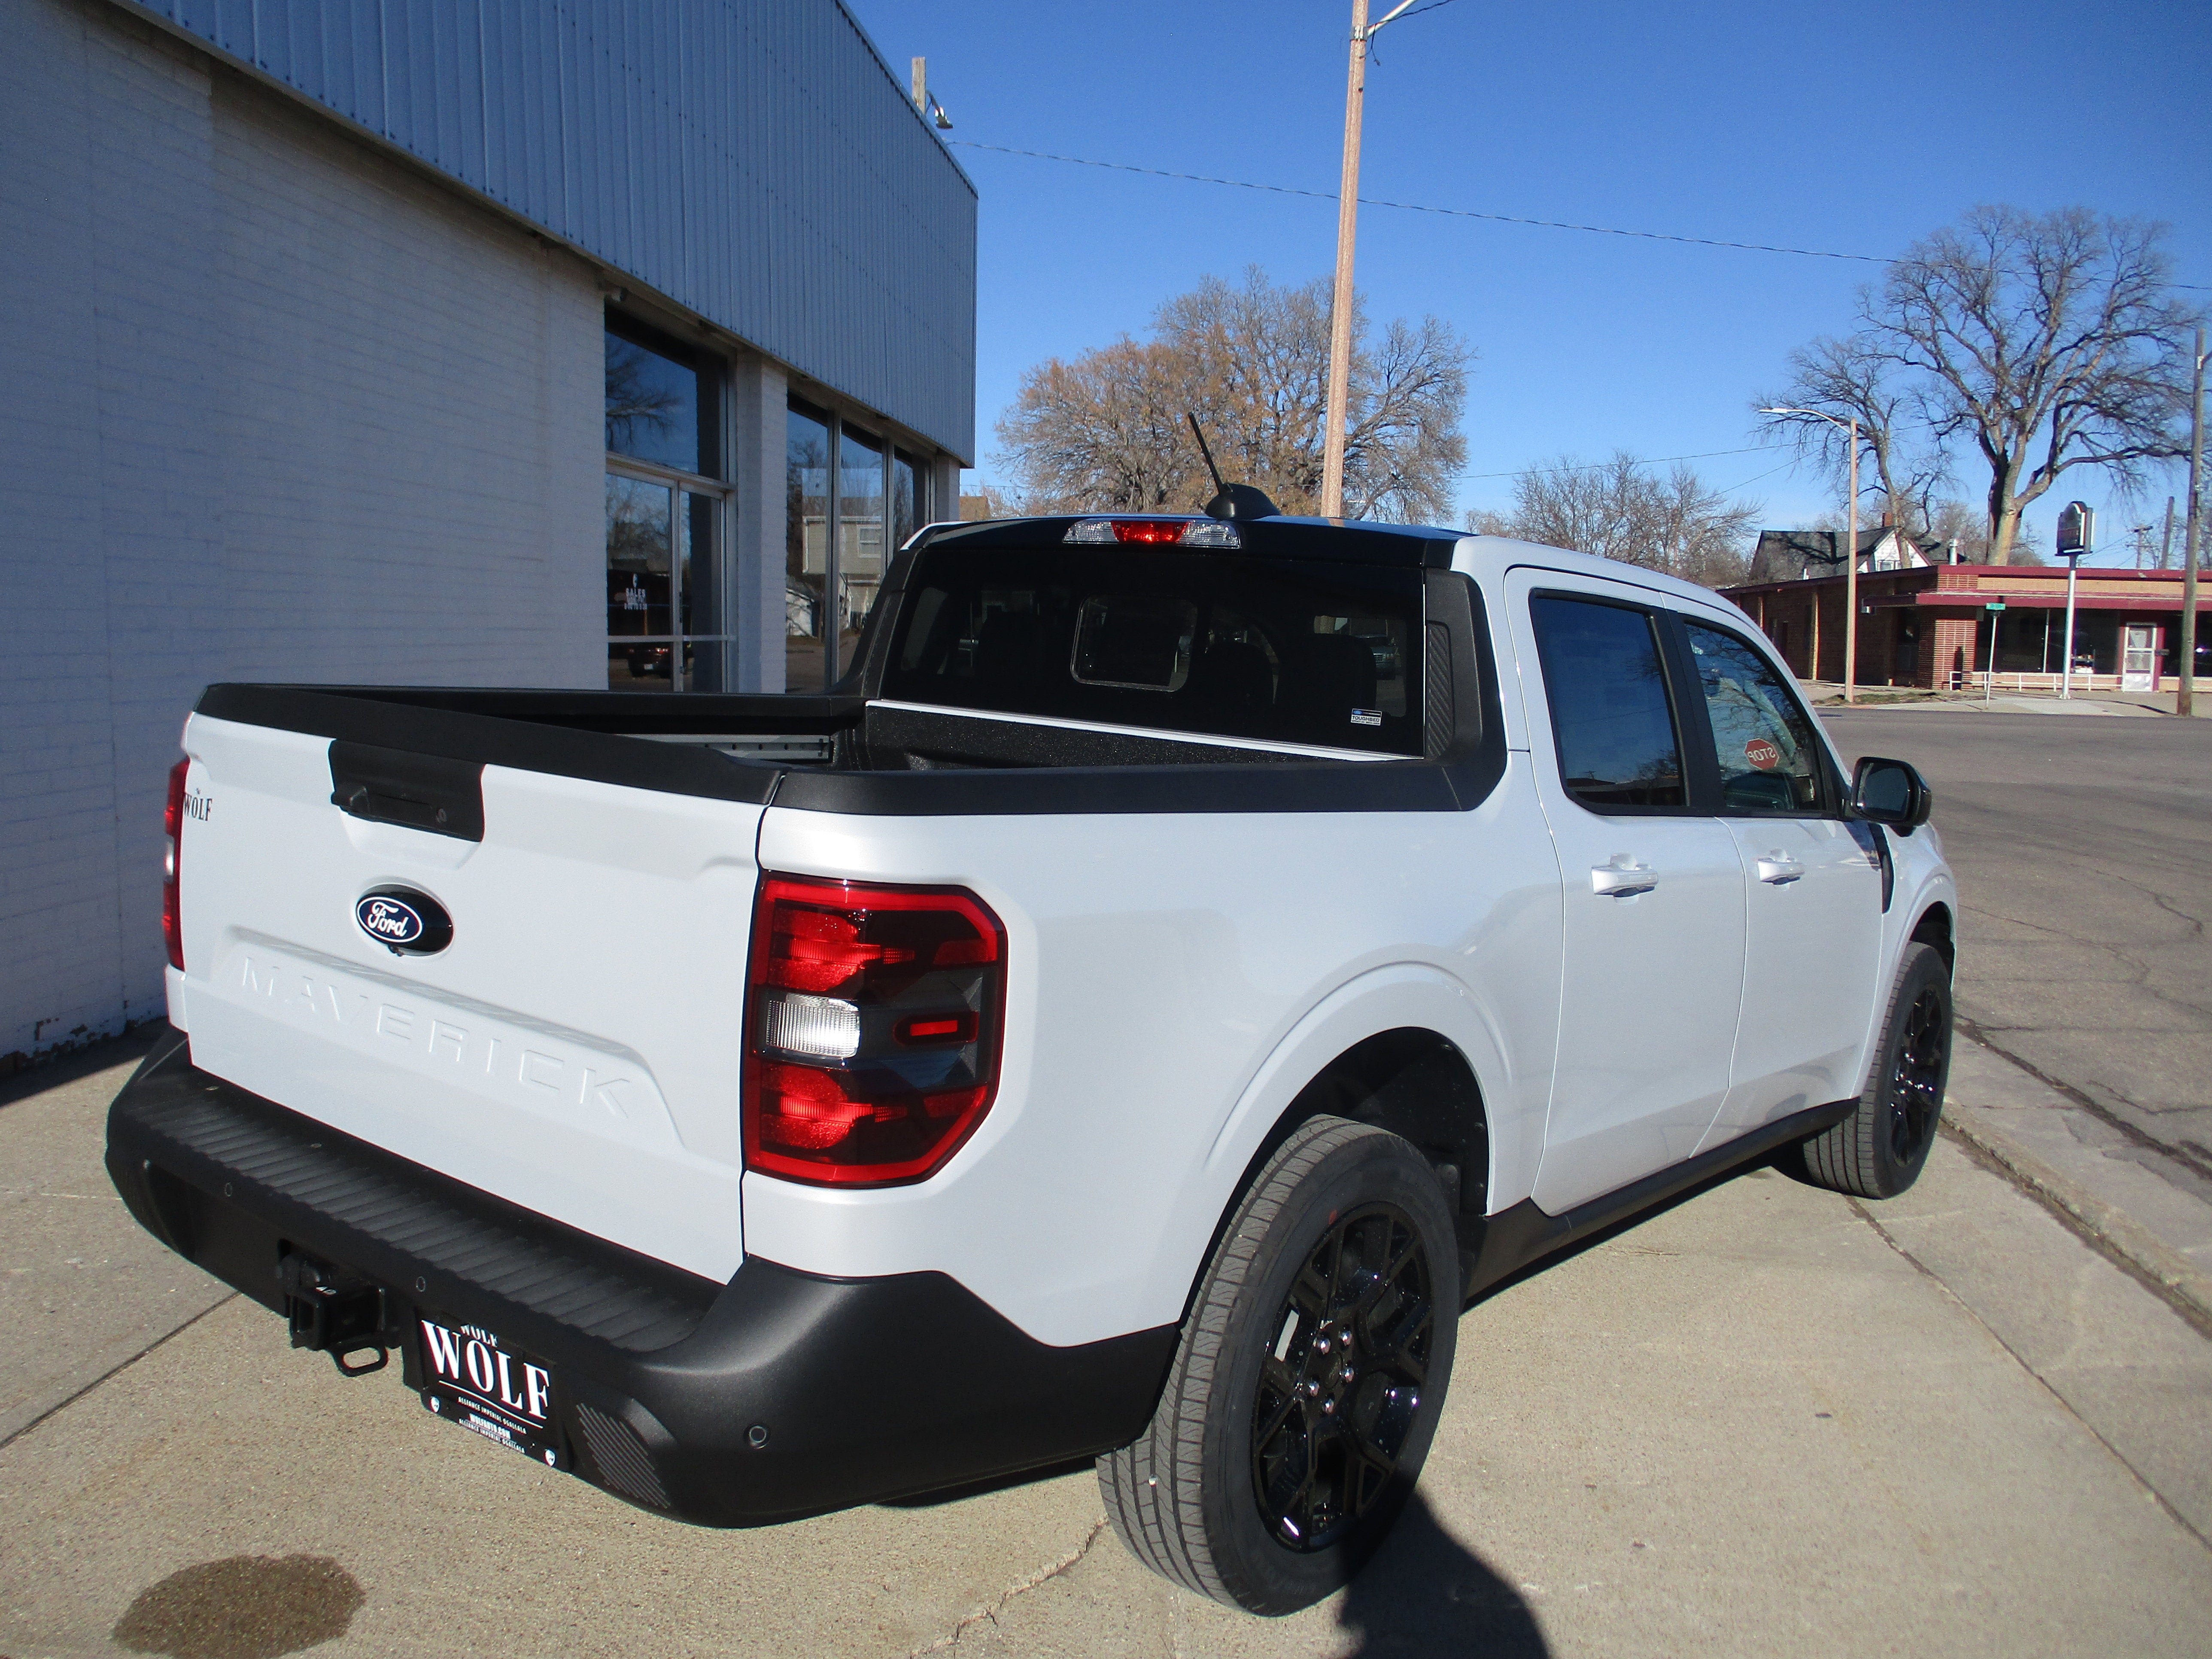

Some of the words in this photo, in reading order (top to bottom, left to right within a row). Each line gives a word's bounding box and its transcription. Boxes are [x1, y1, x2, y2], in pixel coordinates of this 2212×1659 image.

[183, 794, 213, 821] WOLF
[367, 902, 408, 937] Ford
[242, 957, 631, 1118] MAVERICK
[460, 1324, 498, 1348] WOLF
[421, 1319, 550, 1420] WOLF
[458, 1396, 480, 1412] ALLIANCE
[481, 1406, 502, 1423] IMPERIAL
